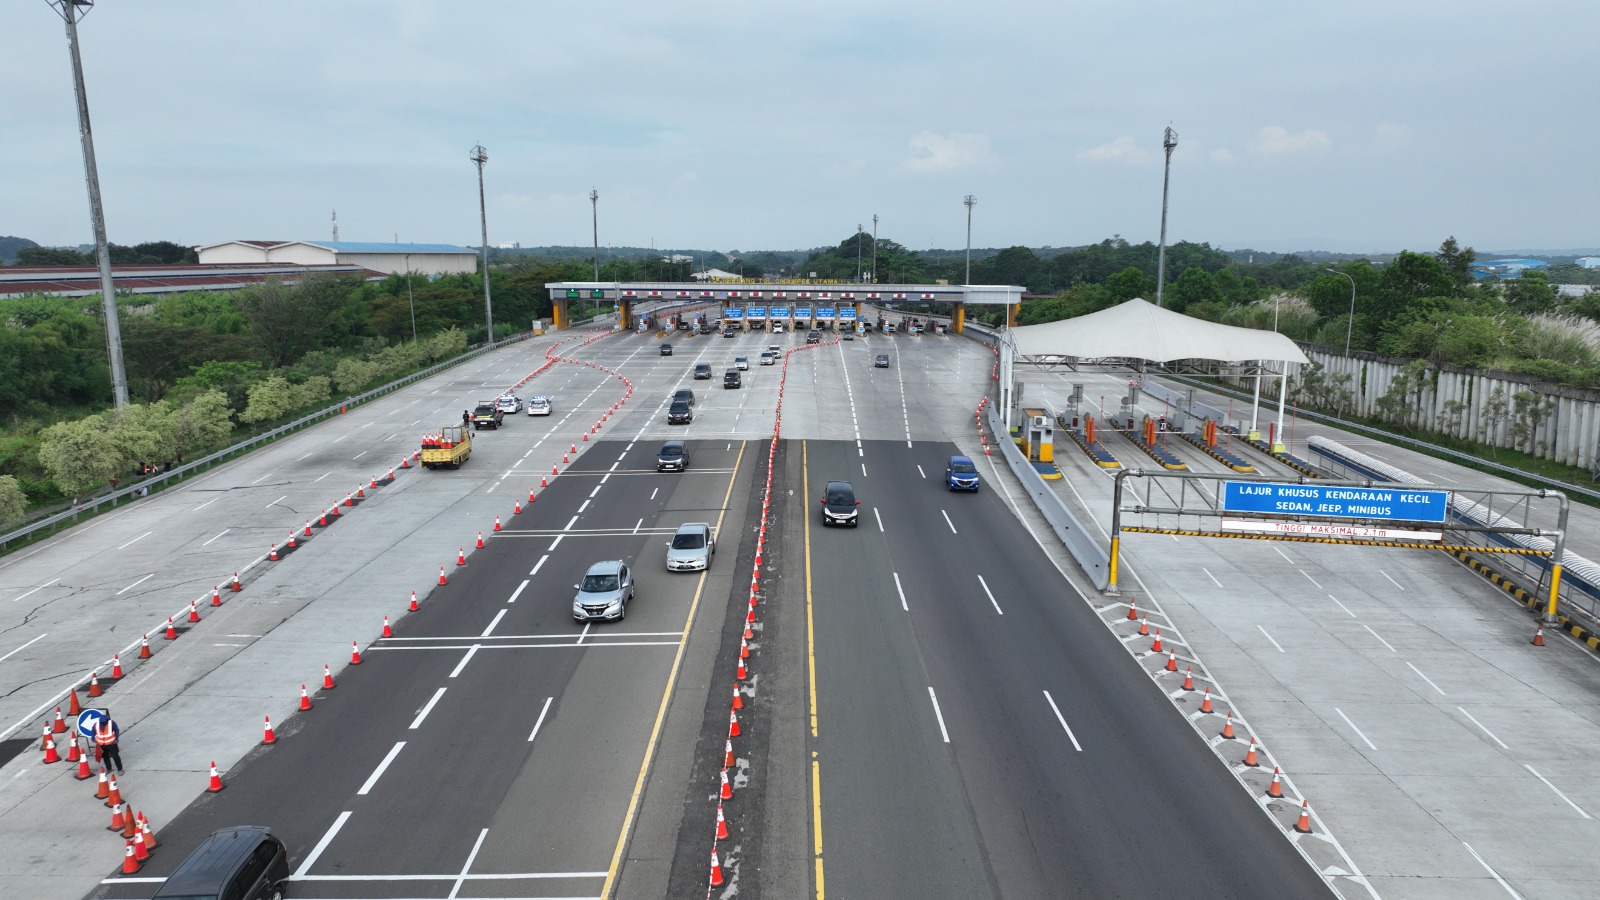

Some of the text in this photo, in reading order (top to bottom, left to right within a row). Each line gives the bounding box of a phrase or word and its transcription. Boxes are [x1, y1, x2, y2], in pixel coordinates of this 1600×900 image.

[1240, 486, 1430, 504] LAJUR KHUSUS KENDARAAN KECIL
[1276, 502, 1392, 515] SEDAN, JEEP, MINIBUS
[1276, 523, 1306, 532] TINGGI
